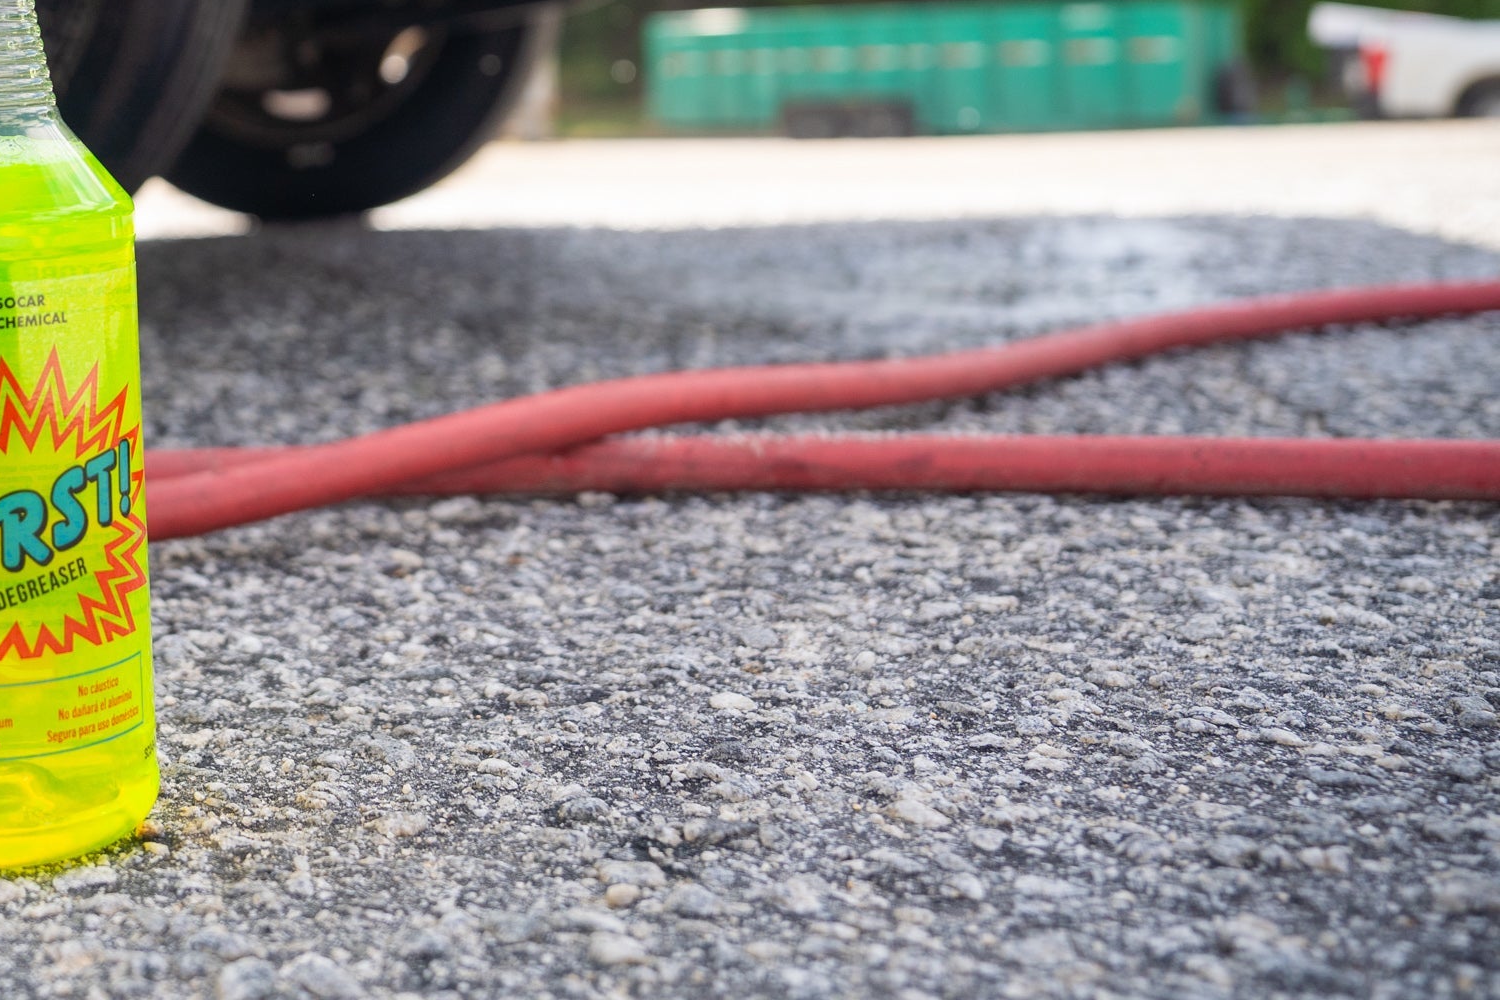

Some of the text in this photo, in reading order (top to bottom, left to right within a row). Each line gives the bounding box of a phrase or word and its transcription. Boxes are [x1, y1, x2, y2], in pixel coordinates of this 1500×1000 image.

[78, 685, 88, 697] No
[58, 708, 69, 720] No
[100, 698, 107, 710] el
[46, 728, 76, 743] Segura
[78, 723, 96, 739] para
[97, 721, 110, 731] uso
